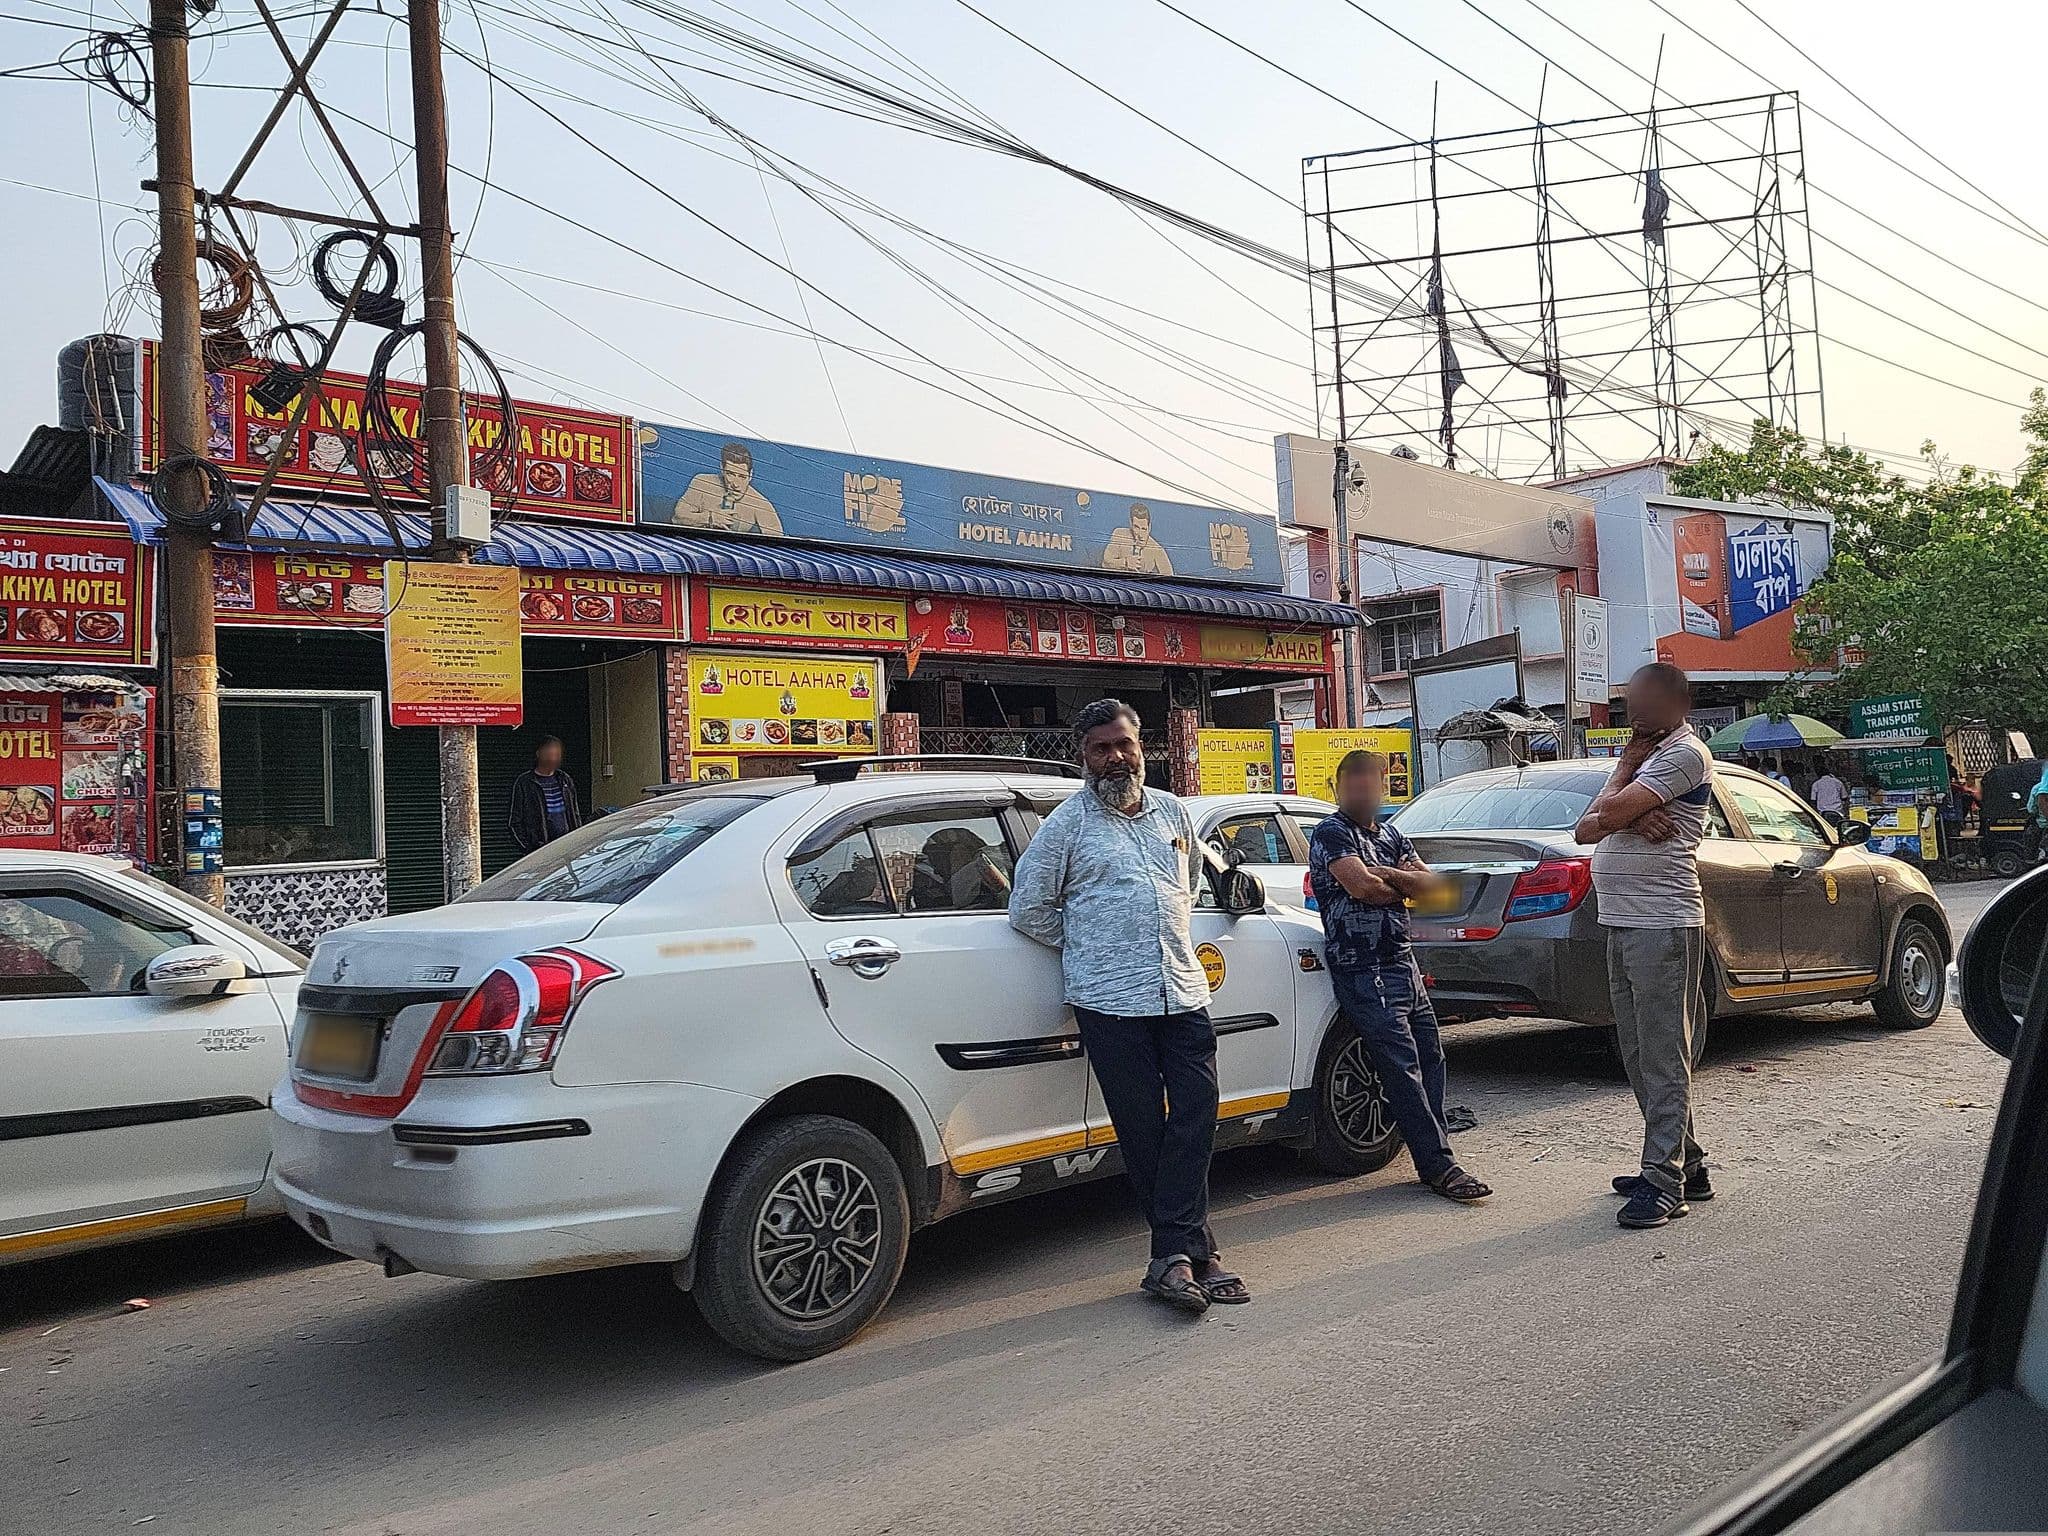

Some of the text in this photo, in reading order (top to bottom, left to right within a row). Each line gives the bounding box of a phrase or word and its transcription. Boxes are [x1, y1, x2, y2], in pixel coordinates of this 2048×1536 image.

[244, 384, 308, 424] NW
[391, 406, 534, 455] KAKHA
[541, 428, 616, 465] HOTEL
[962, 492, 1013, 518] হোটেল
[959, 522, 1073, 551] HOTEL AAHAR
[45, 551, 126, 574] হোটেল
[0, 576, 127, 606] KHYA HOTEL
[564, 576, 664, 596] হোটেল
[722, 600, 813, 630] হোটেল
[1263, 641, 1318, 661] AAHAR
[726, 669, 847, 689] HOTEL AAHAR
[1861, 699, 1922, 716] ASSAM STATE
[1865, 712, 1921, 728] TRANSPORT
[1203, 740, 1265, 752] HOTEL AAHAR
[1328, 737, 1379, 749] HOTEL AAHAR
[1588, 737, 1608, 745] NORTH
[77, 788, 130, 796] CHICKN
[7, 825, 49, 834] CURRY
[79, 844, 130, 853] MUTTN
